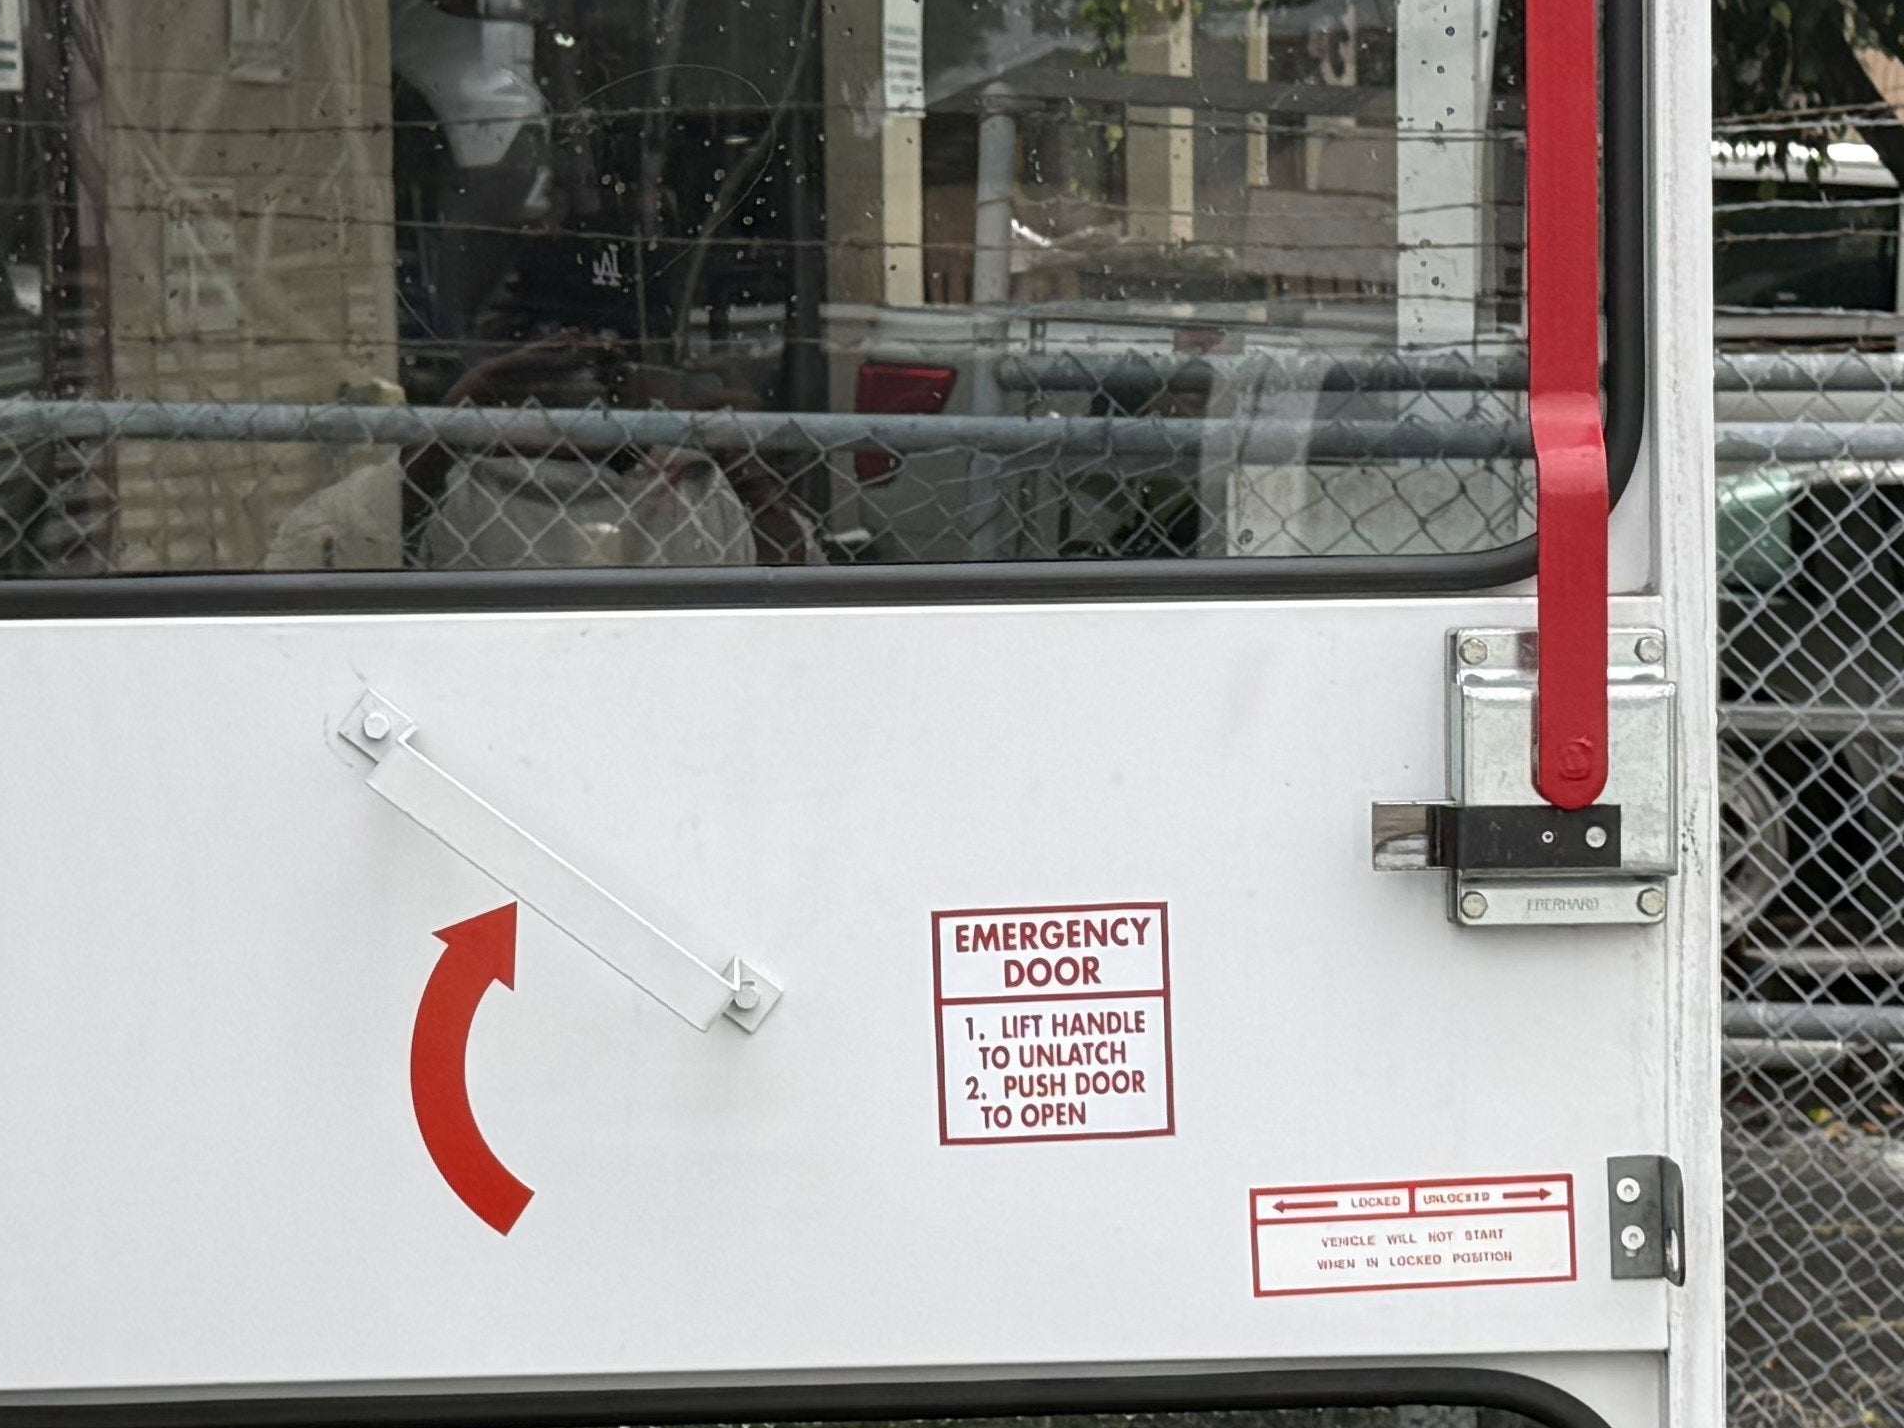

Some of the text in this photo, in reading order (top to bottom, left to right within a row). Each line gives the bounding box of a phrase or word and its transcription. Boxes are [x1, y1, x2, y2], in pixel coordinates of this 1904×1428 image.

[1527, 897, 1599, 911] EBERHARD
[955, 917, 1151, 953] EMERGENCY
[1005, 956, 1101, 987] DOOR
[966, 1011, 1145, 1040] 1. LIFT HANDLE
[979, 1041, 1126, 1069] TO UNLATCH
[966, 1070, 1145, 1100] 2. PUSH DOOR
[981, 1102, 1085, 1128] TO OPEN
[1351, 1195, 1401, 1209] LOCKED
[1423, 1192, 1490, 1205] UNLOCKED
[1321, 1228, 1504, 1248] VEHICLE WILL NOT START
[1316, 1250, 1513, 1270] WHEN IN LOCKED POSITION
